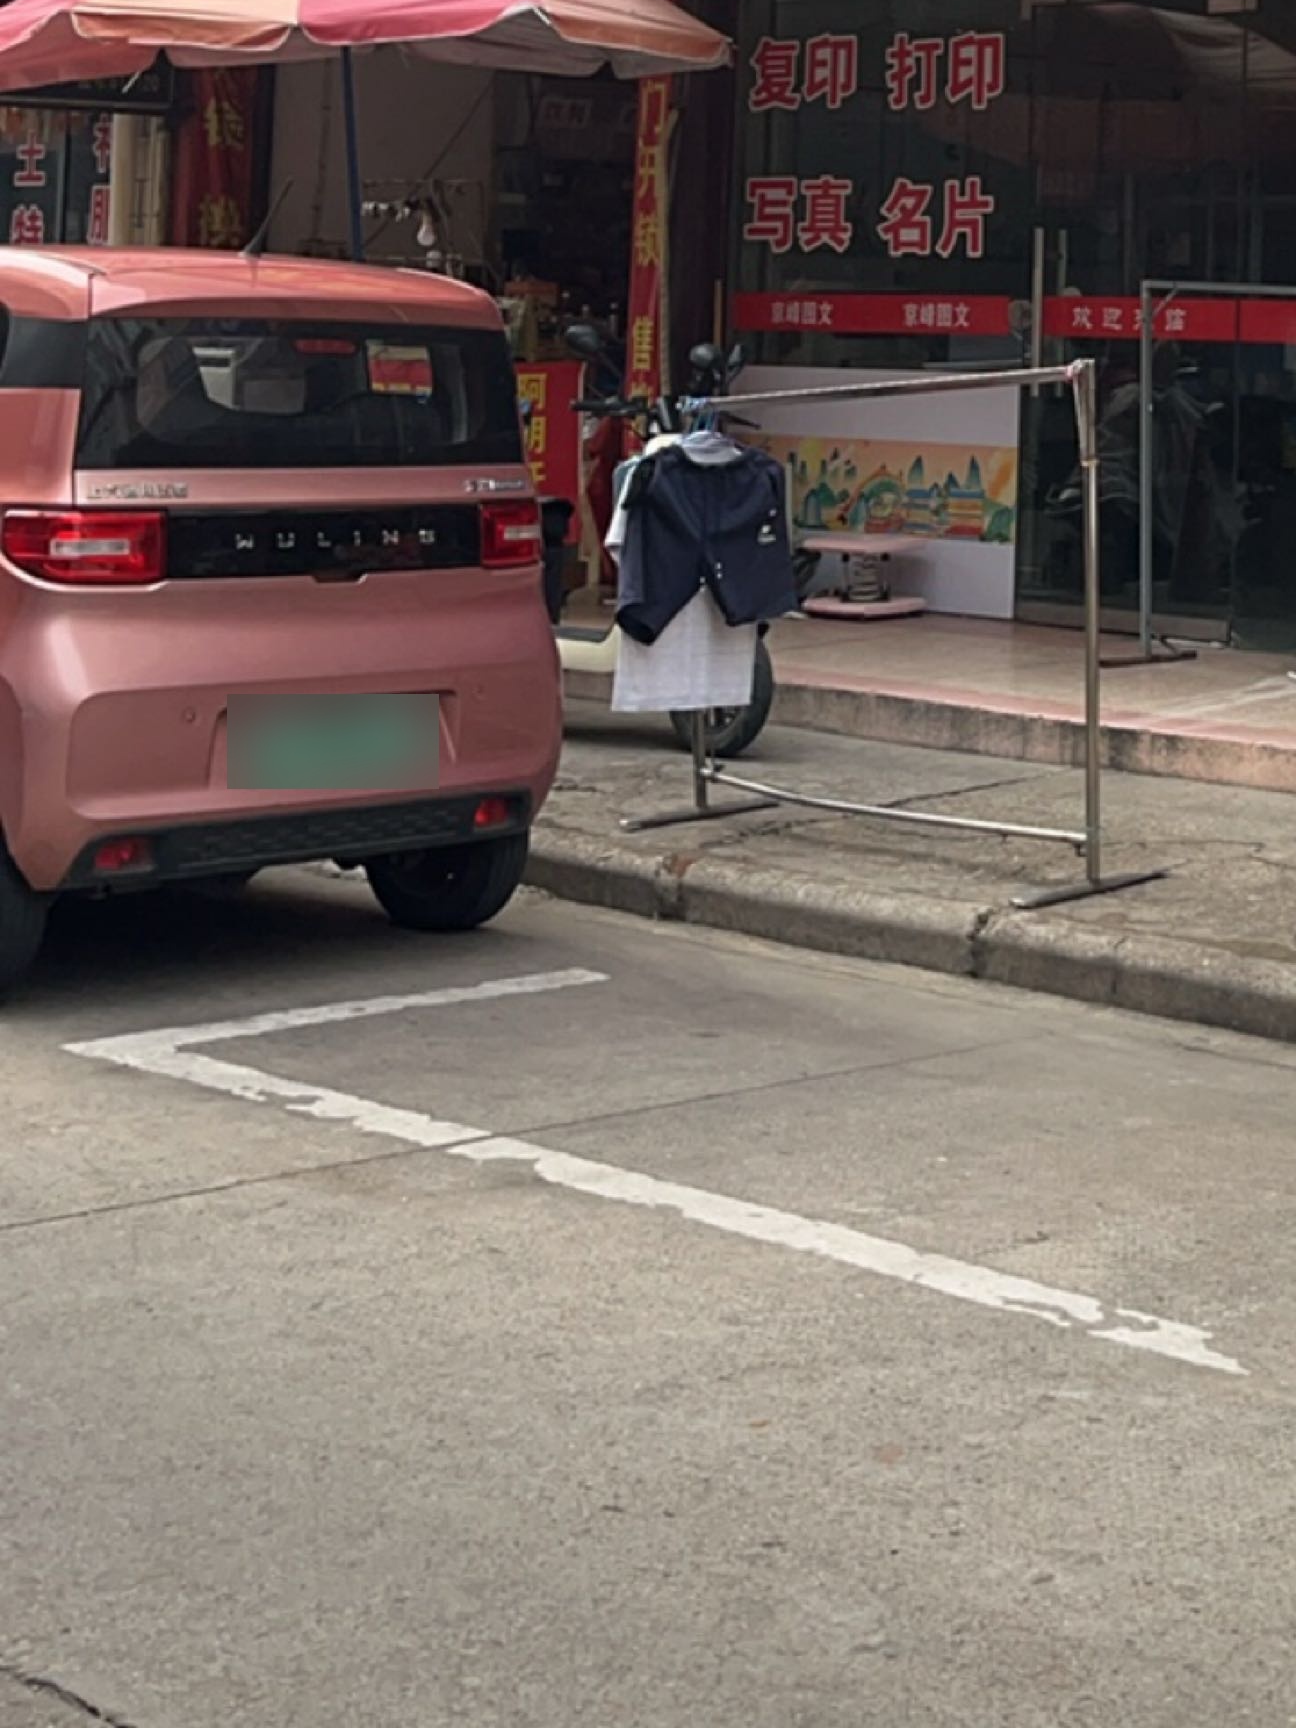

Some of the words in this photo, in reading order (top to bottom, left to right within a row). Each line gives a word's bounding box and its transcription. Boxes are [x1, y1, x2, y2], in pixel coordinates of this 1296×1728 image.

[750, 33, 857, 111] 复印
[887, 31, 1003, 110] 打印
[745, 176, 854, 253] 写真
[878, 177, 994, 257] 名片
[904, 302, 970, 329] 京峰图文
